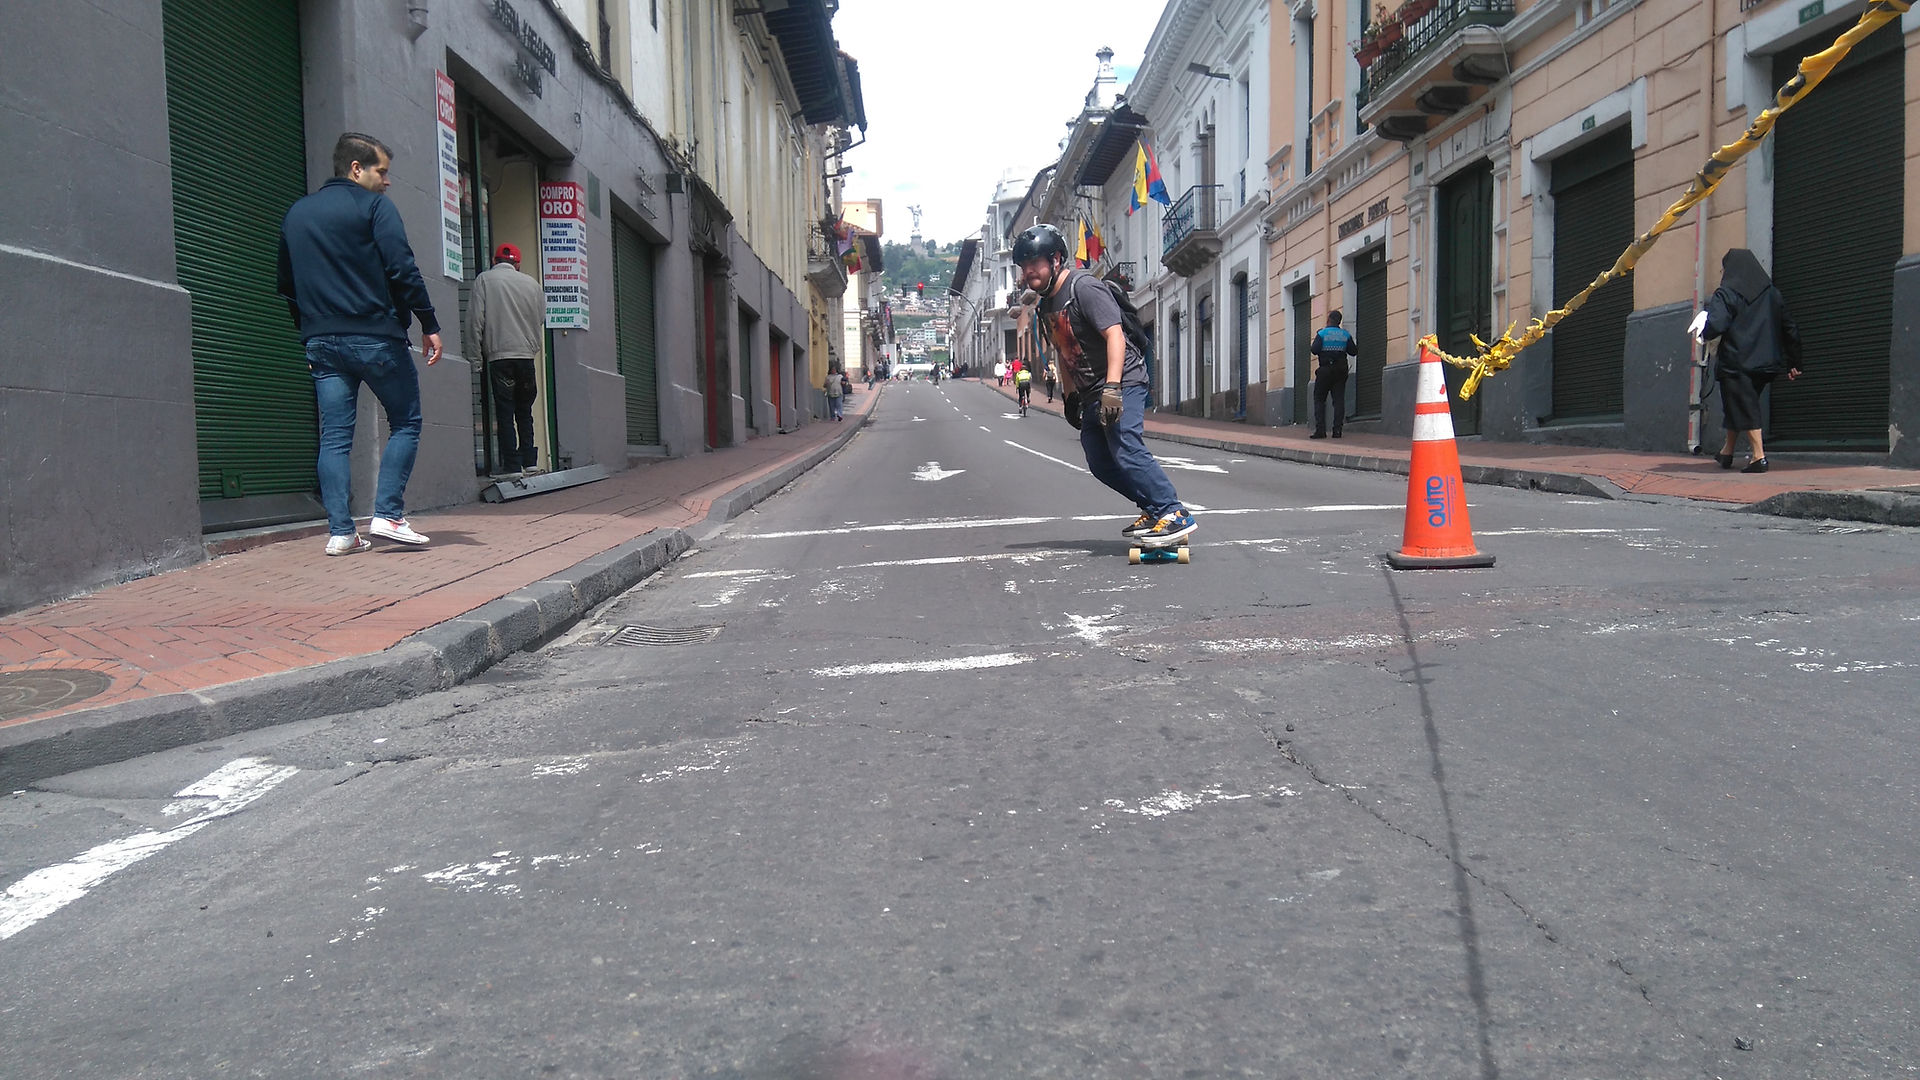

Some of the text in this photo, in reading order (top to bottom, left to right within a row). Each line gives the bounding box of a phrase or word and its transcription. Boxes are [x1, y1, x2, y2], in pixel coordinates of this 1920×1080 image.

[440, 98, 454, 124] ORO
[540, 186, 575, 200] COMPRO
[543, 201, 573, 215] ORO
[544, 285, 579, 293] REPARACIONES DE
